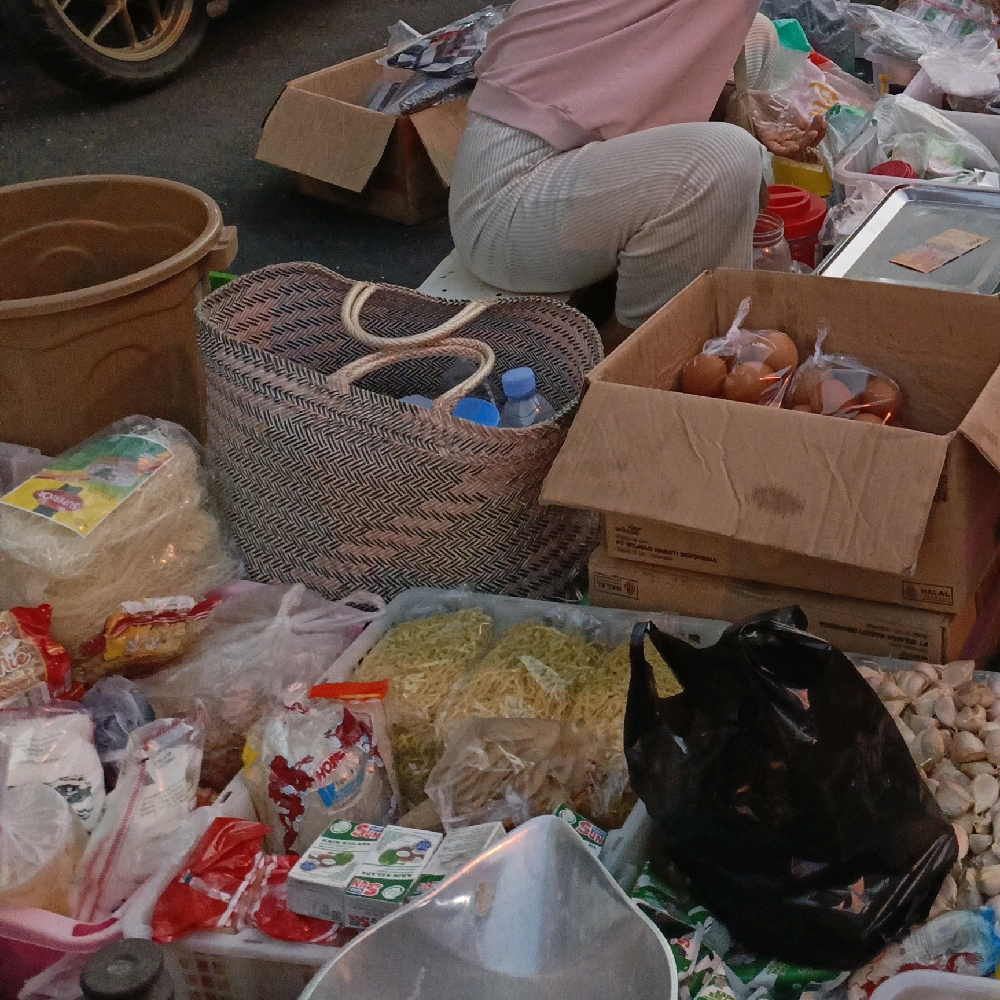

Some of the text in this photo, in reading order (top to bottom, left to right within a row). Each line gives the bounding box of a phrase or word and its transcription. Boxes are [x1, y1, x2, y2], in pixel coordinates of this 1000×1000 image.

[40, 490, 78, 511] SUPERIOR
[351, 823, 382, 839] SUN
[577, 820, 604, 844] SUN
[351, 877, 383, 897] SUN
